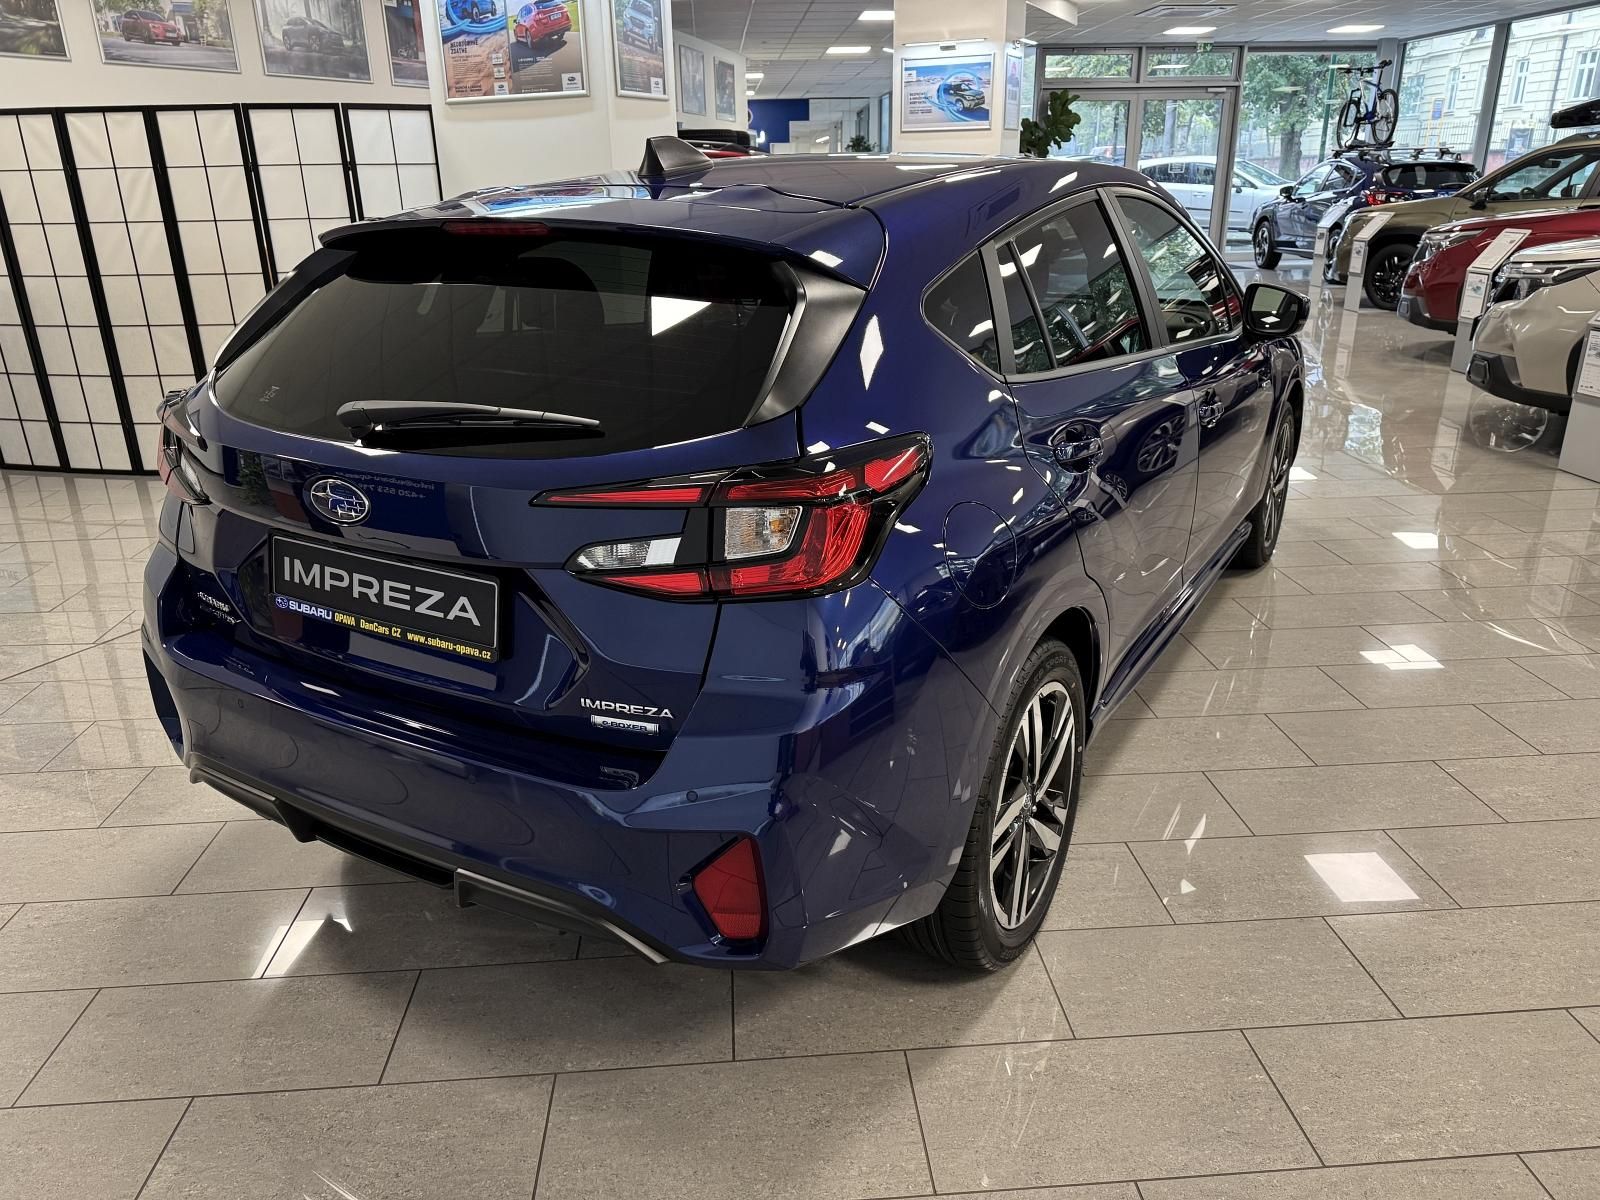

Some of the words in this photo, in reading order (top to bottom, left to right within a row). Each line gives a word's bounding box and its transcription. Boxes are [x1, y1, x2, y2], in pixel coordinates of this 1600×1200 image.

[283, 556, 481, 627] IMPREZA
[289, 600, 332, 620] SUBARU
[334, 612, 356, 627] OPAVA
[360, 619, 390, 636] DanCars
[391, 626, 401, 638] CZ
[407, 631, 492, 660] www.subaru-opava.cz
[580, 697, 675, 720] IMPREZA
